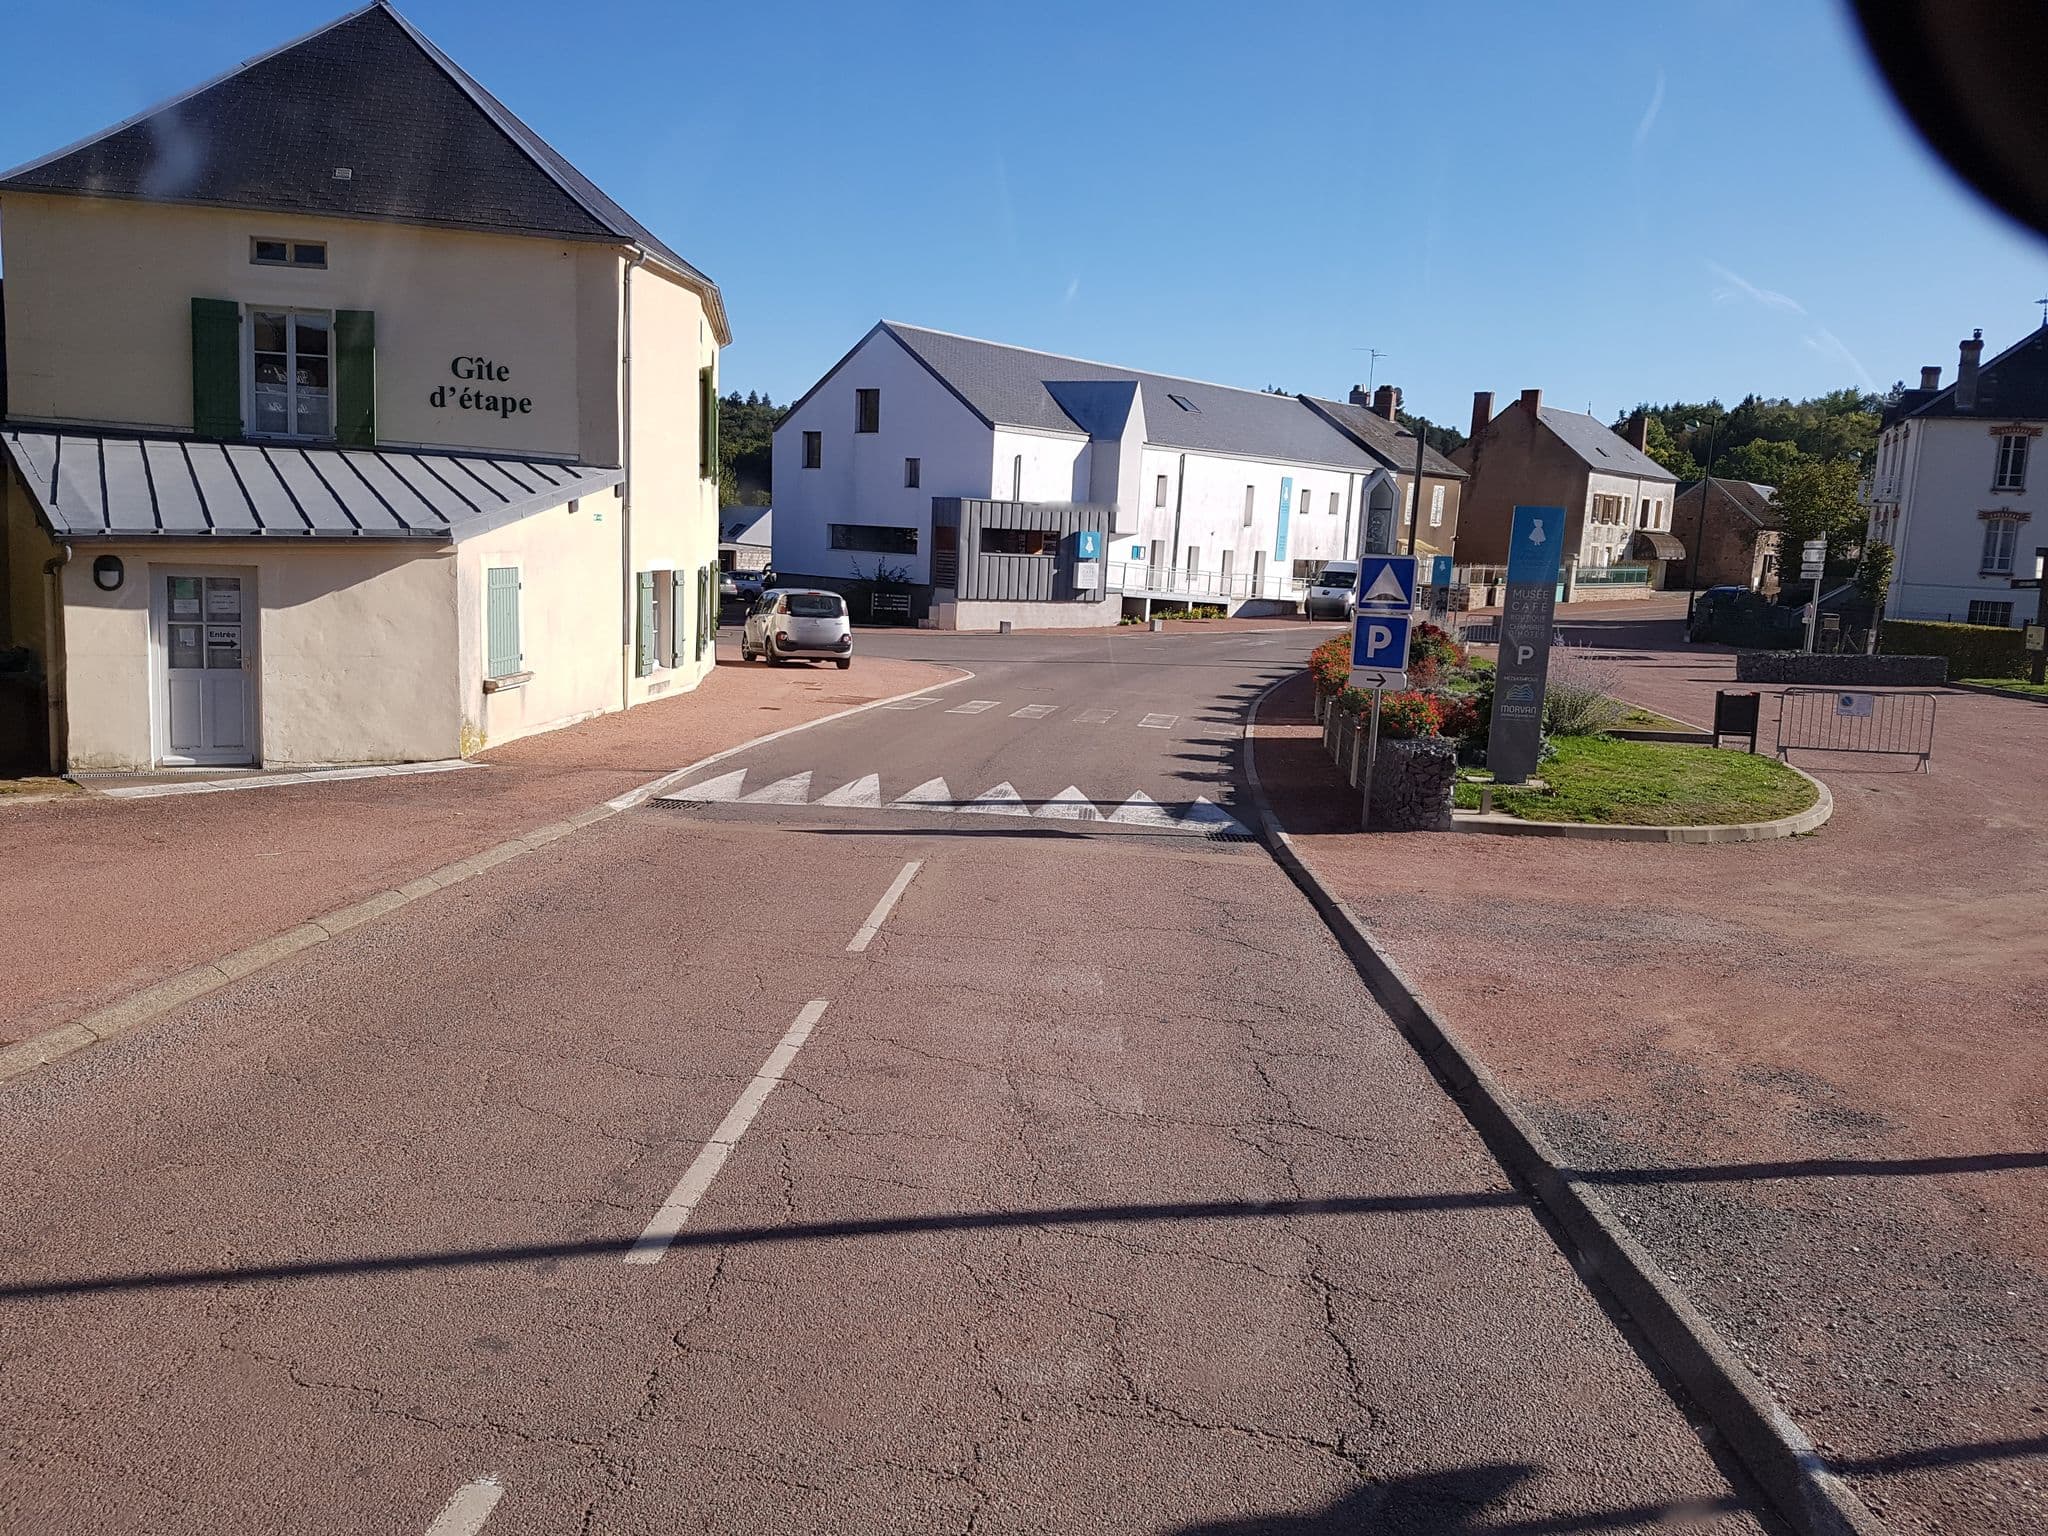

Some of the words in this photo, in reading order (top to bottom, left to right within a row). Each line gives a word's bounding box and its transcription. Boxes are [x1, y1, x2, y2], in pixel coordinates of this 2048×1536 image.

[451, 356, 509, 381] Gîte
[429, 386, 532, 418] d'étape
[1513, 588, 1549, 600] MUSÉE
[1511, 601, 1547, 612] CAFÉ
[1367, 625, 1392, 658] P
[1517, 645, 1534, 664] P
